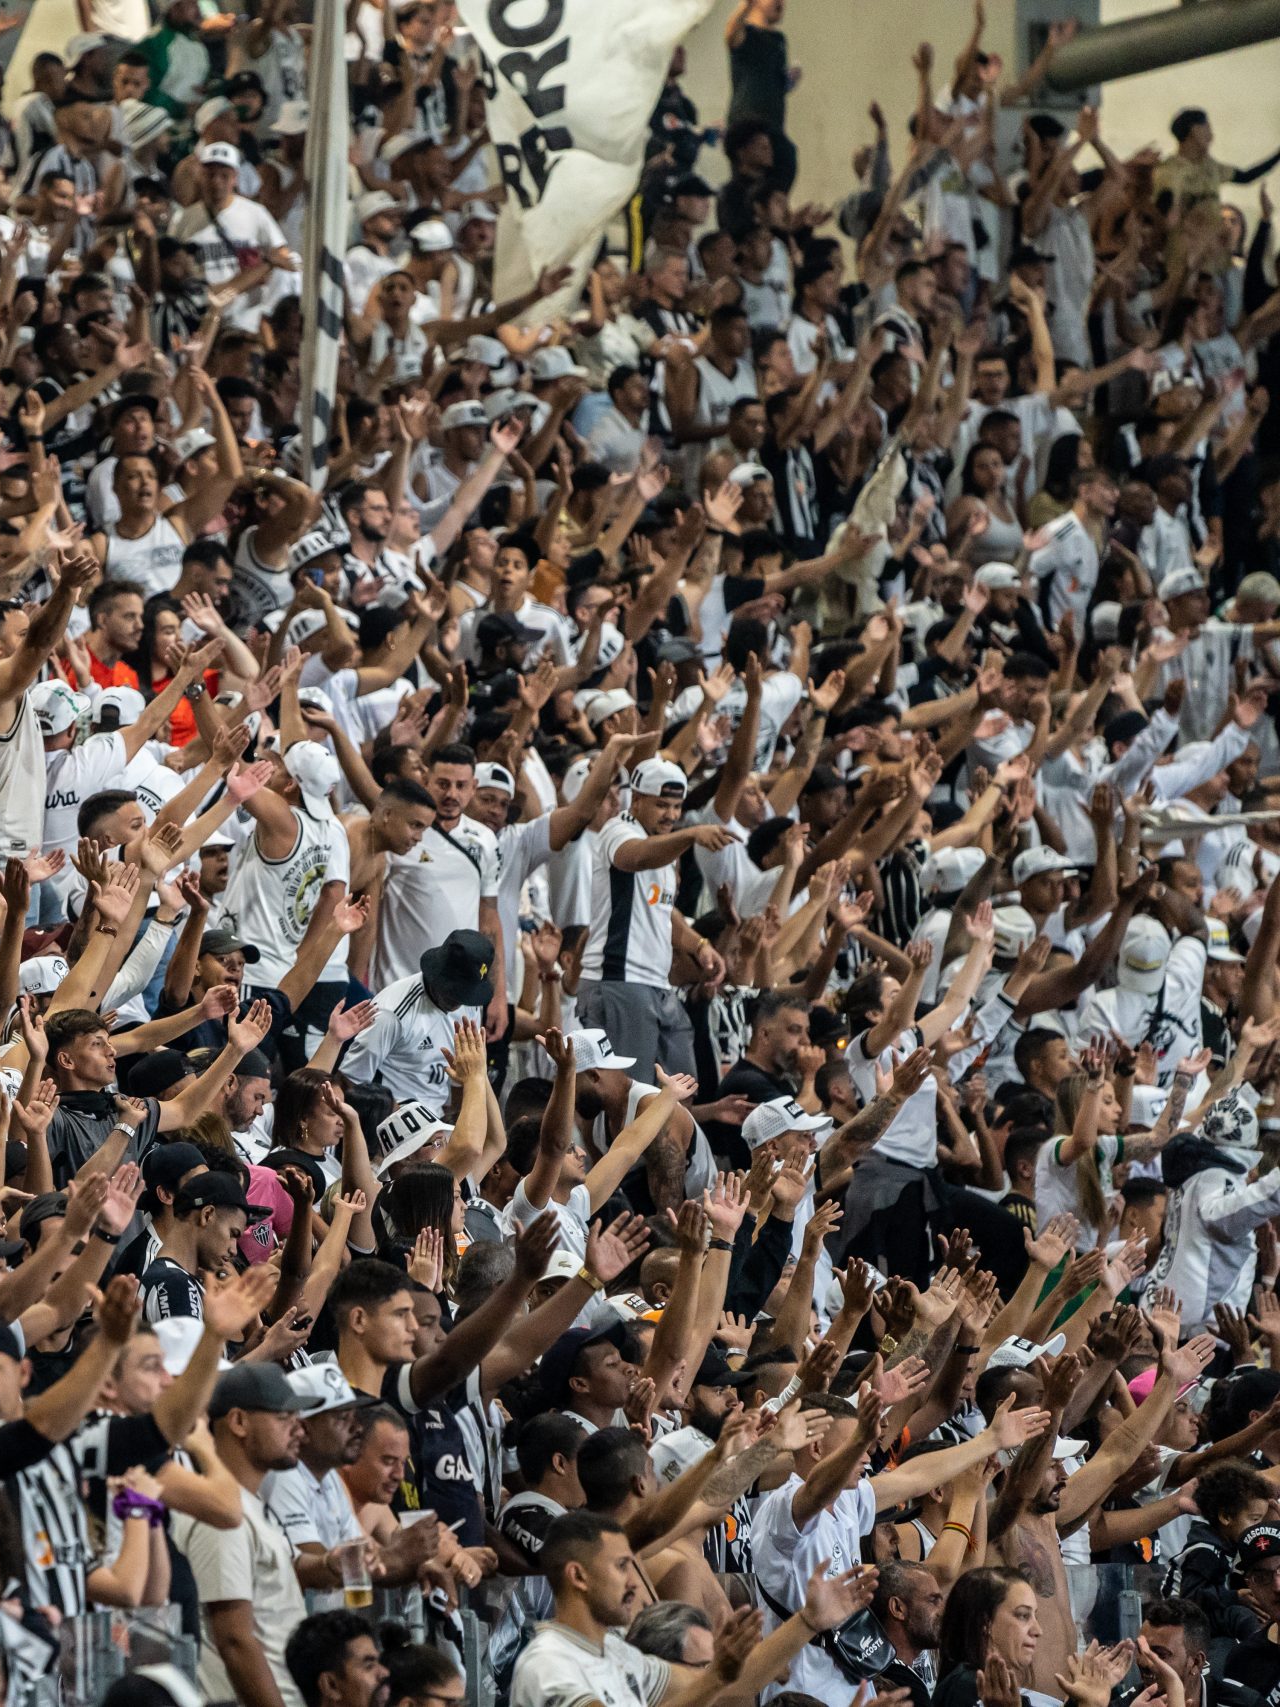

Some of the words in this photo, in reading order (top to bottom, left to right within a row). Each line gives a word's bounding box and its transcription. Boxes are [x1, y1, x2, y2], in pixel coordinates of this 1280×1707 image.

[428, 1063, 445, 1085] 10
[504, 1517, 546, 1554] MRV
[856, 1636, 885, 1662] LACOSTE
